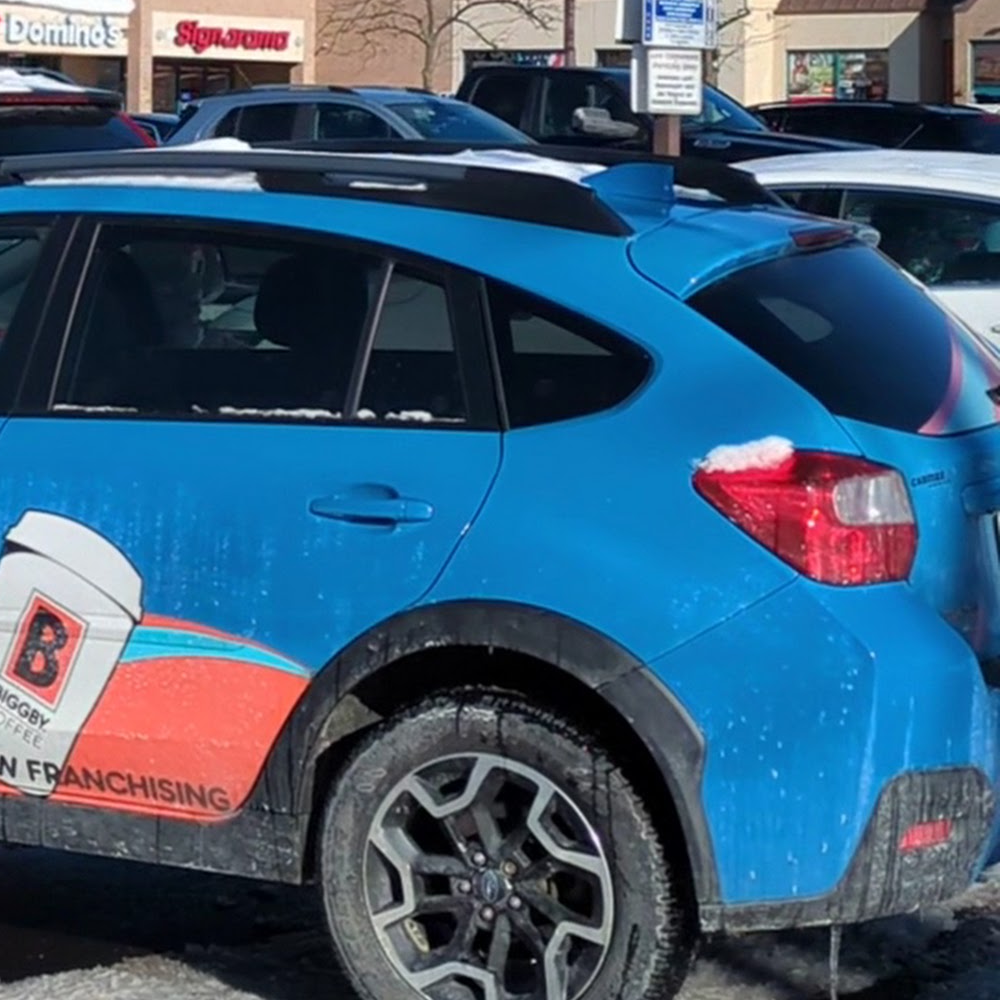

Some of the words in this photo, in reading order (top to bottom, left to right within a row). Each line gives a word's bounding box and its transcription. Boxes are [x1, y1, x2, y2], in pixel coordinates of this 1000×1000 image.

[5, 12, 123, 48] Domino's
[13, 605, 68, 688] B
[27, 759, 231, 812] FRANCHISING
